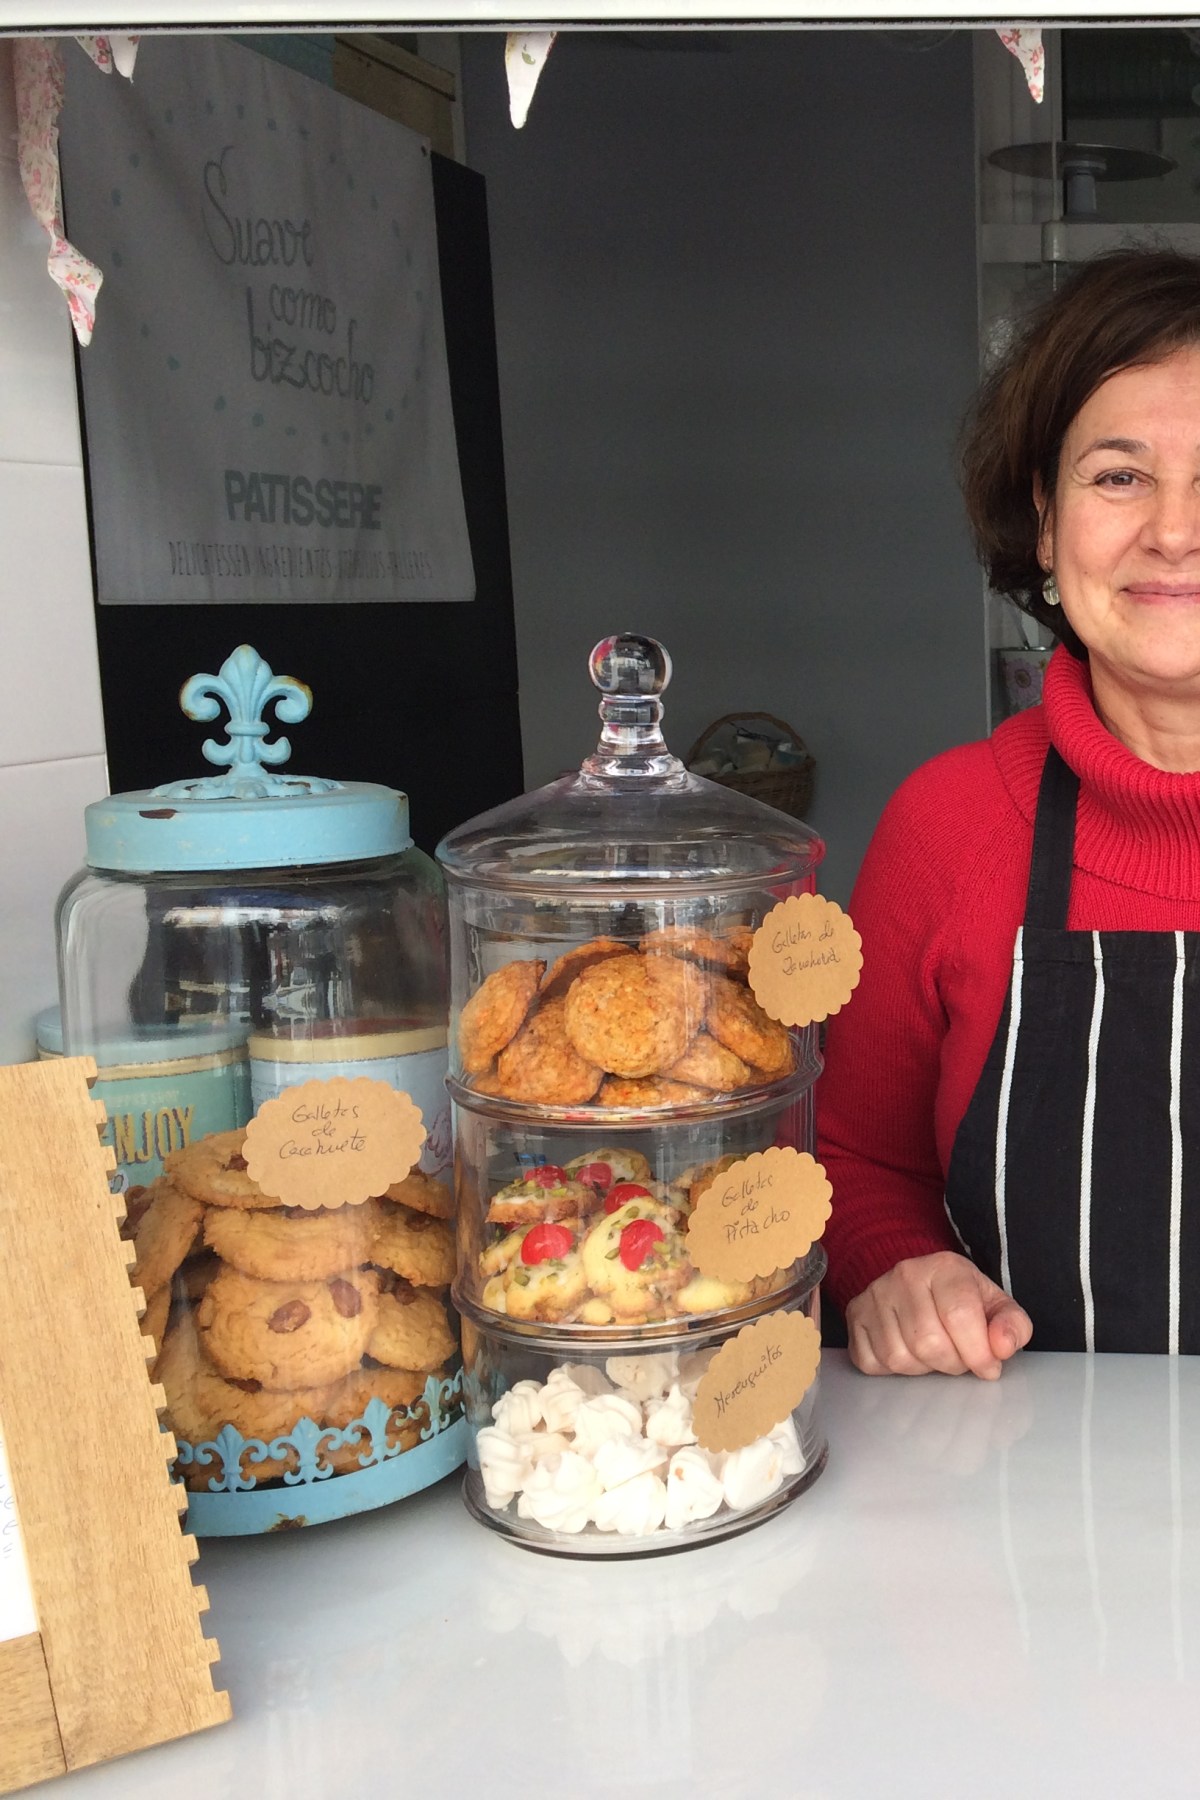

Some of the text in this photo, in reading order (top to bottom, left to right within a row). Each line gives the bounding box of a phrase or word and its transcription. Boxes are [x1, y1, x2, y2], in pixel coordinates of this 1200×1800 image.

[201, 145, 315, 267] Suave
[269, 283, 337, 335] como
[246, 286, 376, 406] bizcocho
[291, 1098, 360, 1123] Galletas
[311, 1121, 337, 1138] de
[102, 1104, 195, 1165] NJOY
[722, 1171, 773, 1208] Galletas
[740, 1198, 759, 1217] de
